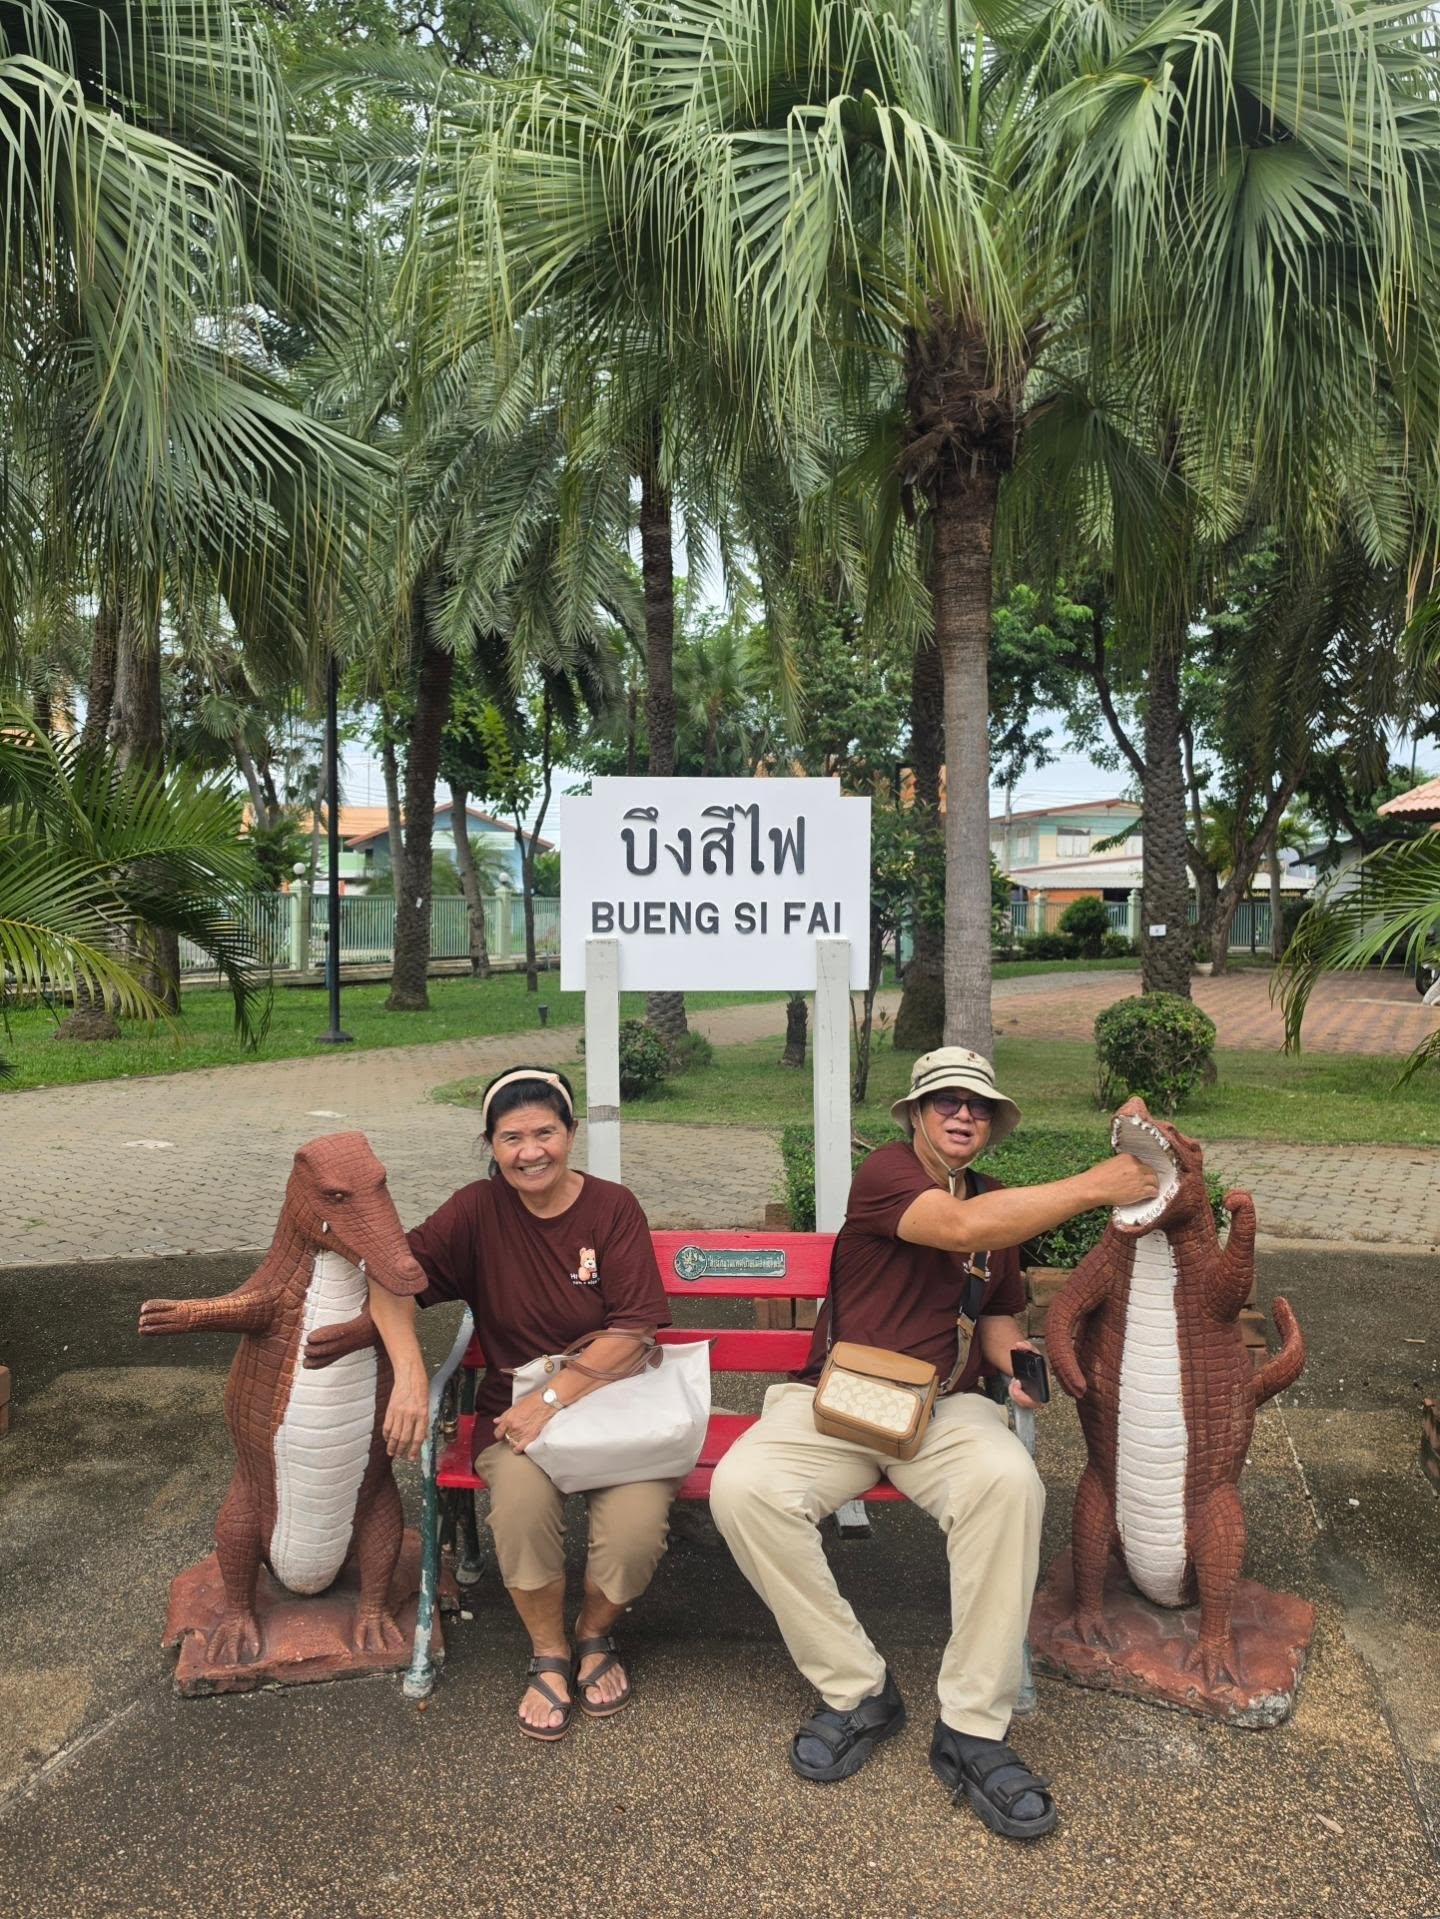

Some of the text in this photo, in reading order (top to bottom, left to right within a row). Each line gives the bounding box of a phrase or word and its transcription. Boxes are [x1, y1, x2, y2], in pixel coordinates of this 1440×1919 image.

[621, 803, 806, 877] บึงสีไฟ
[591, 901, 841, 935] BUENG SI FAI
